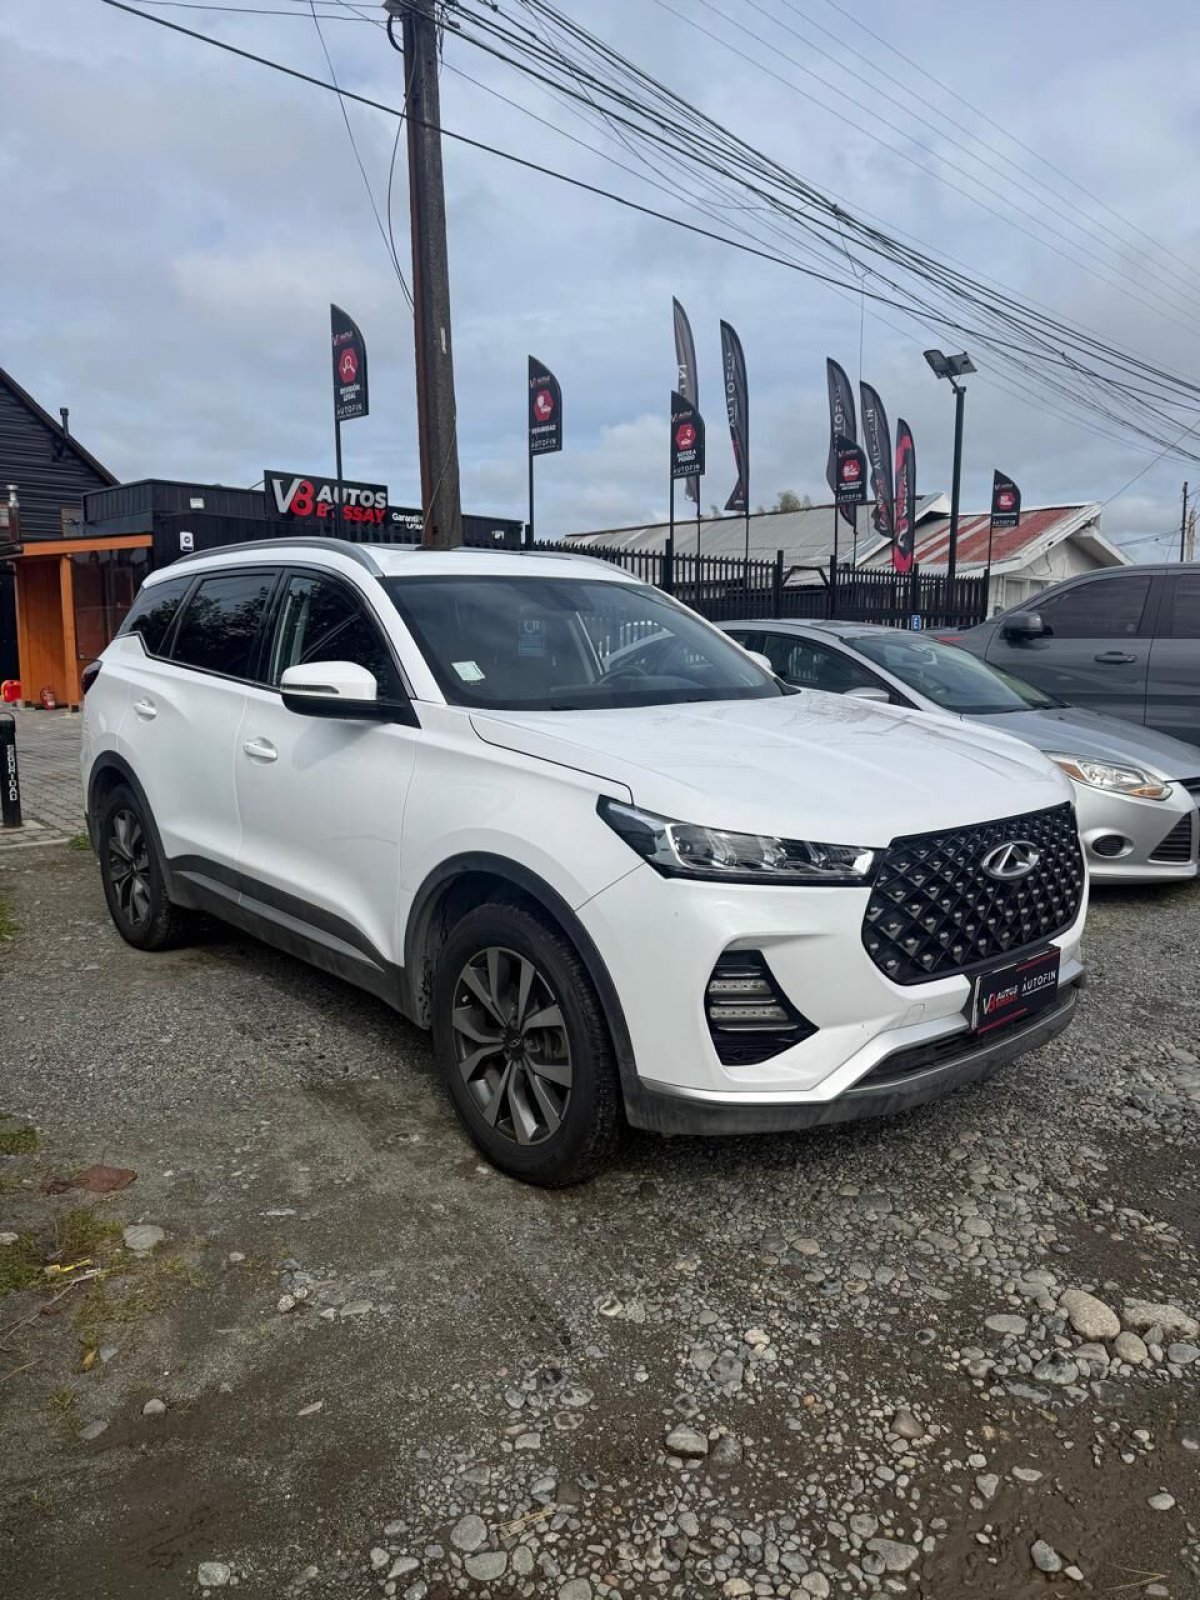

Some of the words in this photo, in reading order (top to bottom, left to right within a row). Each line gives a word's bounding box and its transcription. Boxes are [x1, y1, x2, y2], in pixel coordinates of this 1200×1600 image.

[272, 478, 315, 517] V8
[316, 485, 387, 510] AUTOS
[316, 502, 386, 523] BSSAY
[1022, 970, 1057, 993] AUTOFIN
